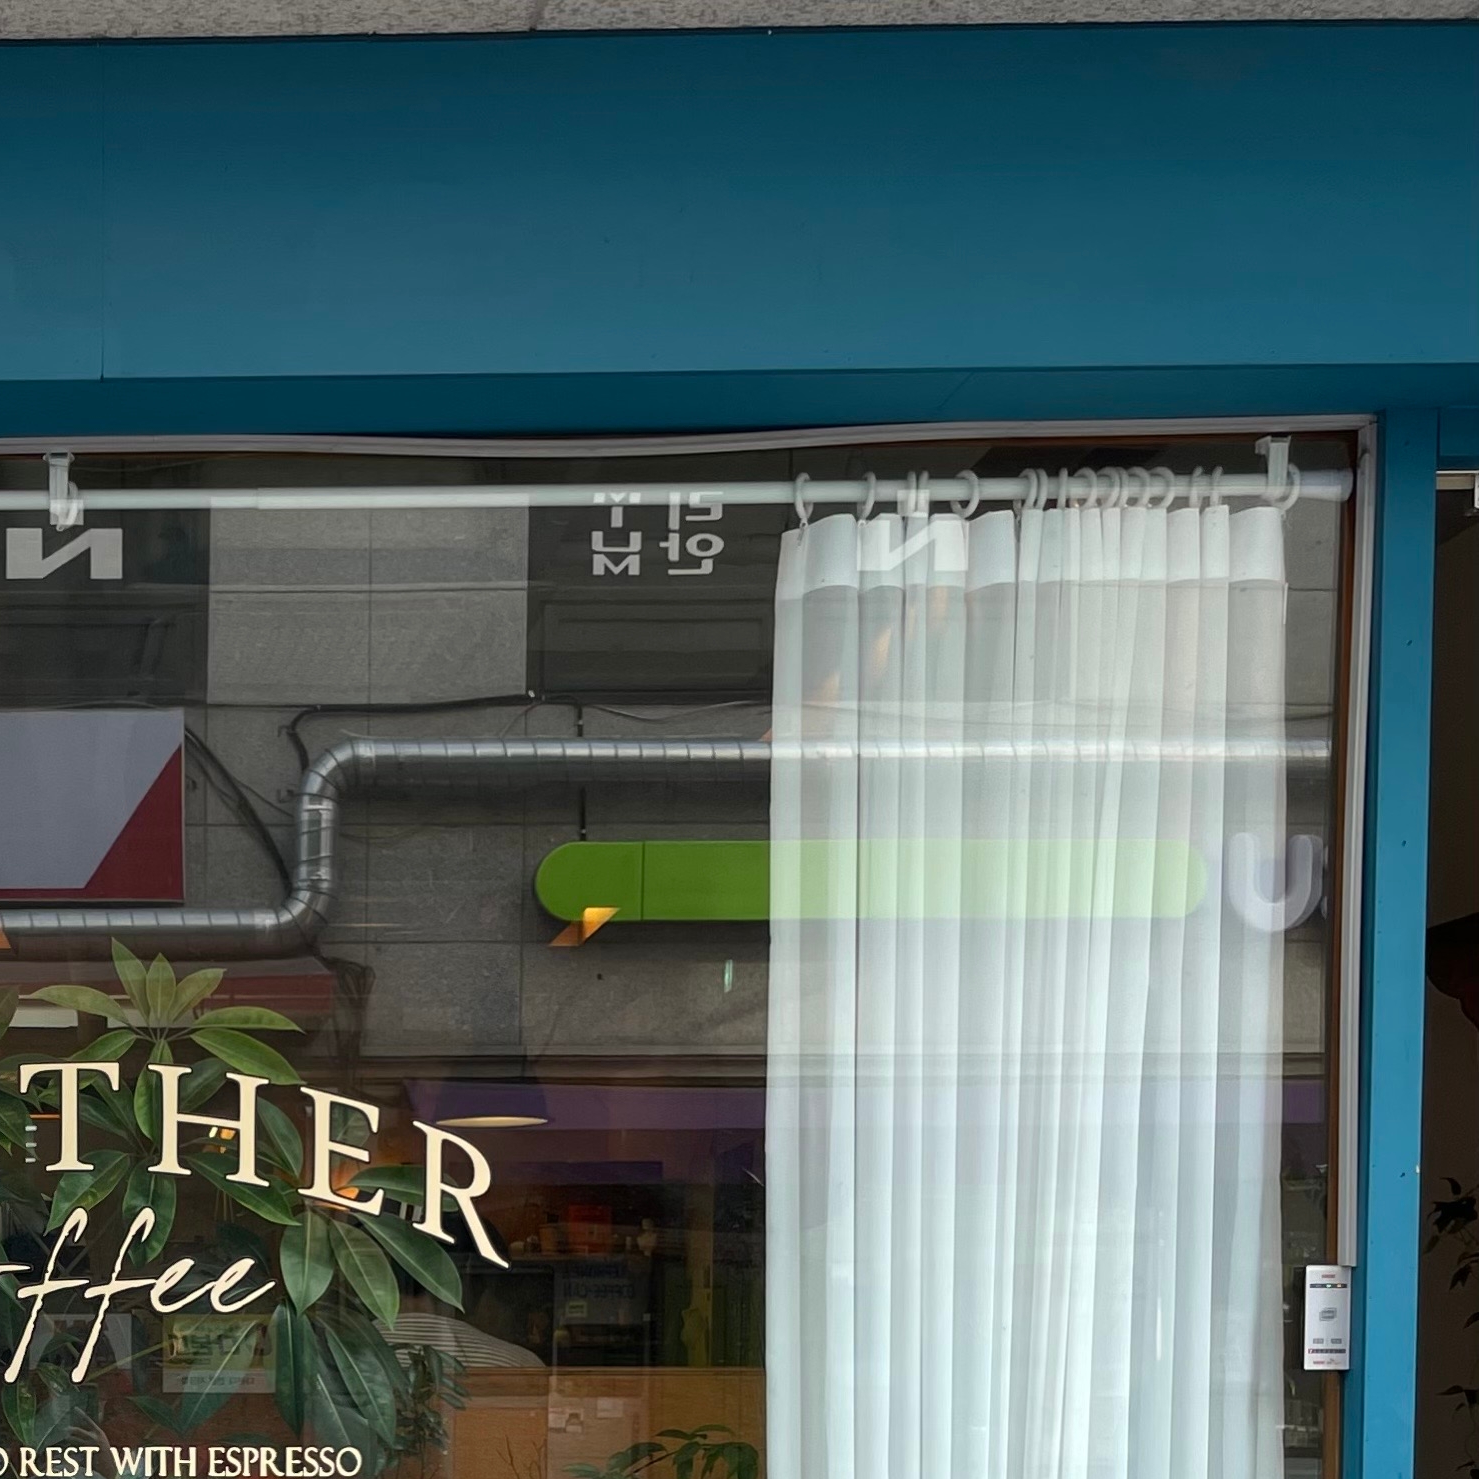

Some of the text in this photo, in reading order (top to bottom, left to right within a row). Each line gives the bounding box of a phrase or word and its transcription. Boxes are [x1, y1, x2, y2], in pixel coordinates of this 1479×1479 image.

[19, 1446, 99, 1478] REST
[109, 1446, 198, 1478] WITH
[207, 1446, 363, 1478] ESPRESSO
